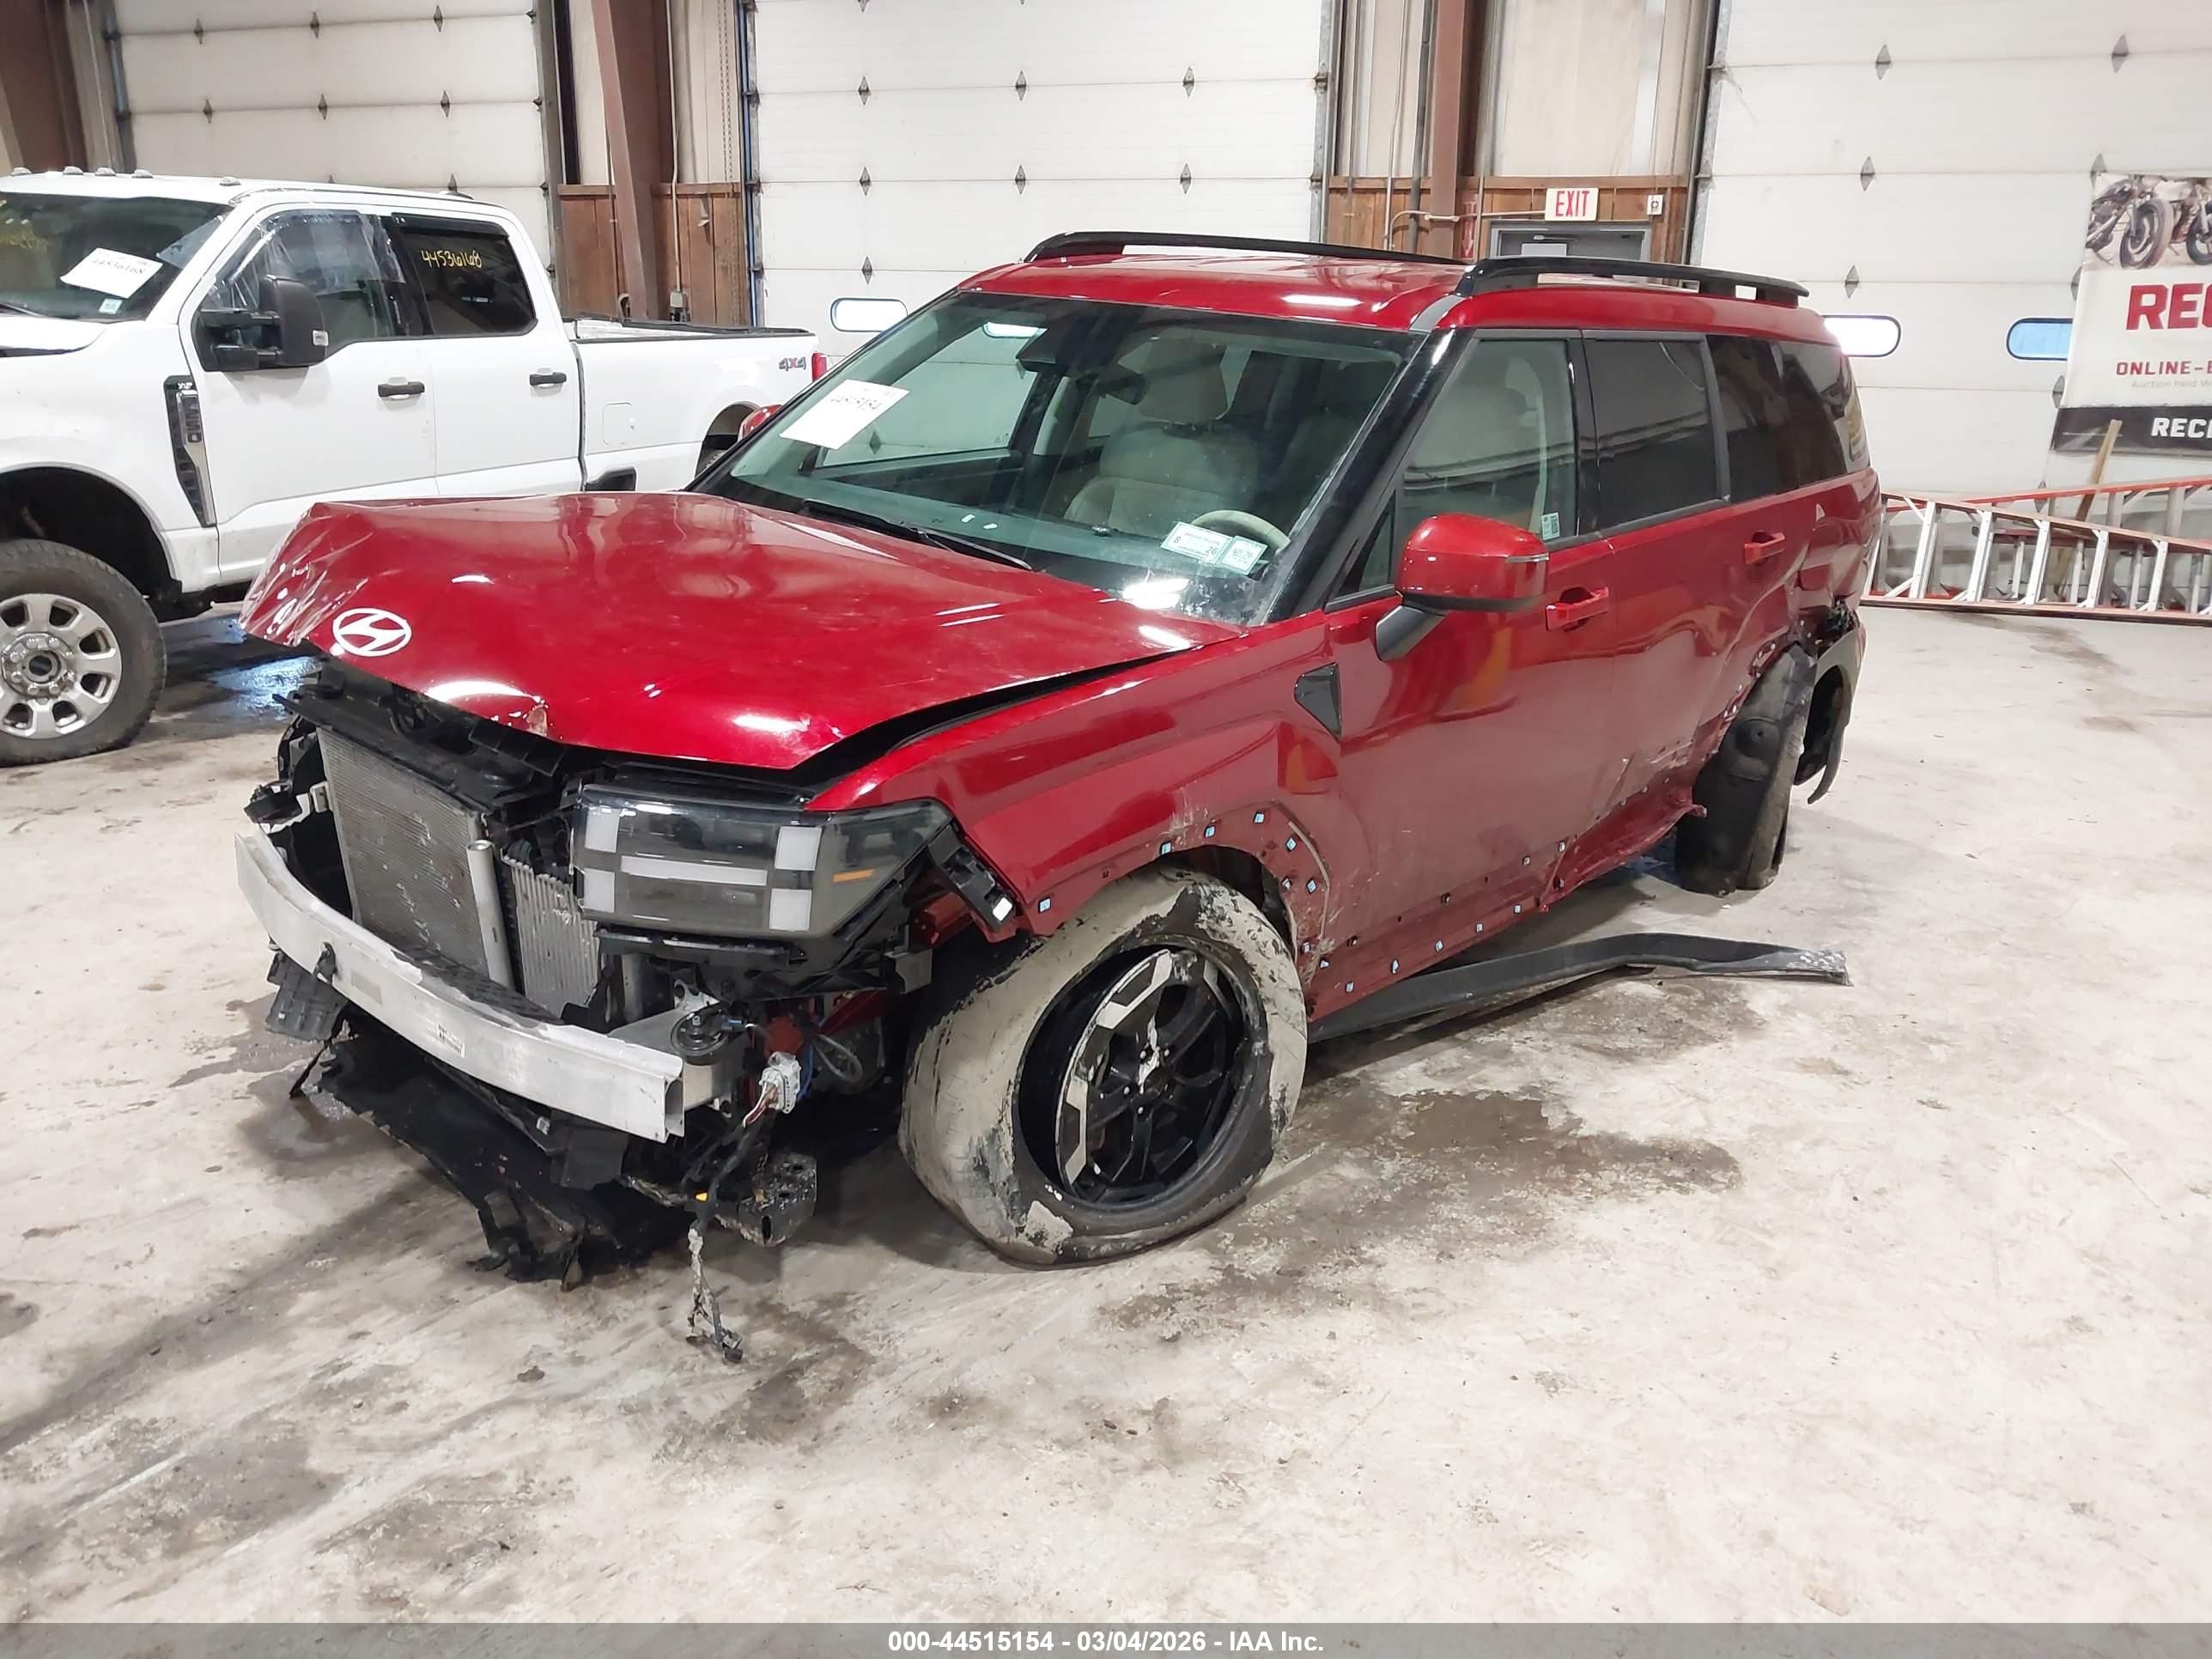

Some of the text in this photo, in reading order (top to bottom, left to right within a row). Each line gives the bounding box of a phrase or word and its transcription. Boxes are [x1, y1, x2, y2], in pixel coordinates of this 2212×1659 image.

[1556, 191, 1589, 216] EXIT
[421, 250, 482, 268] 44536168
[2131, 380, 2172, 388] Auction
